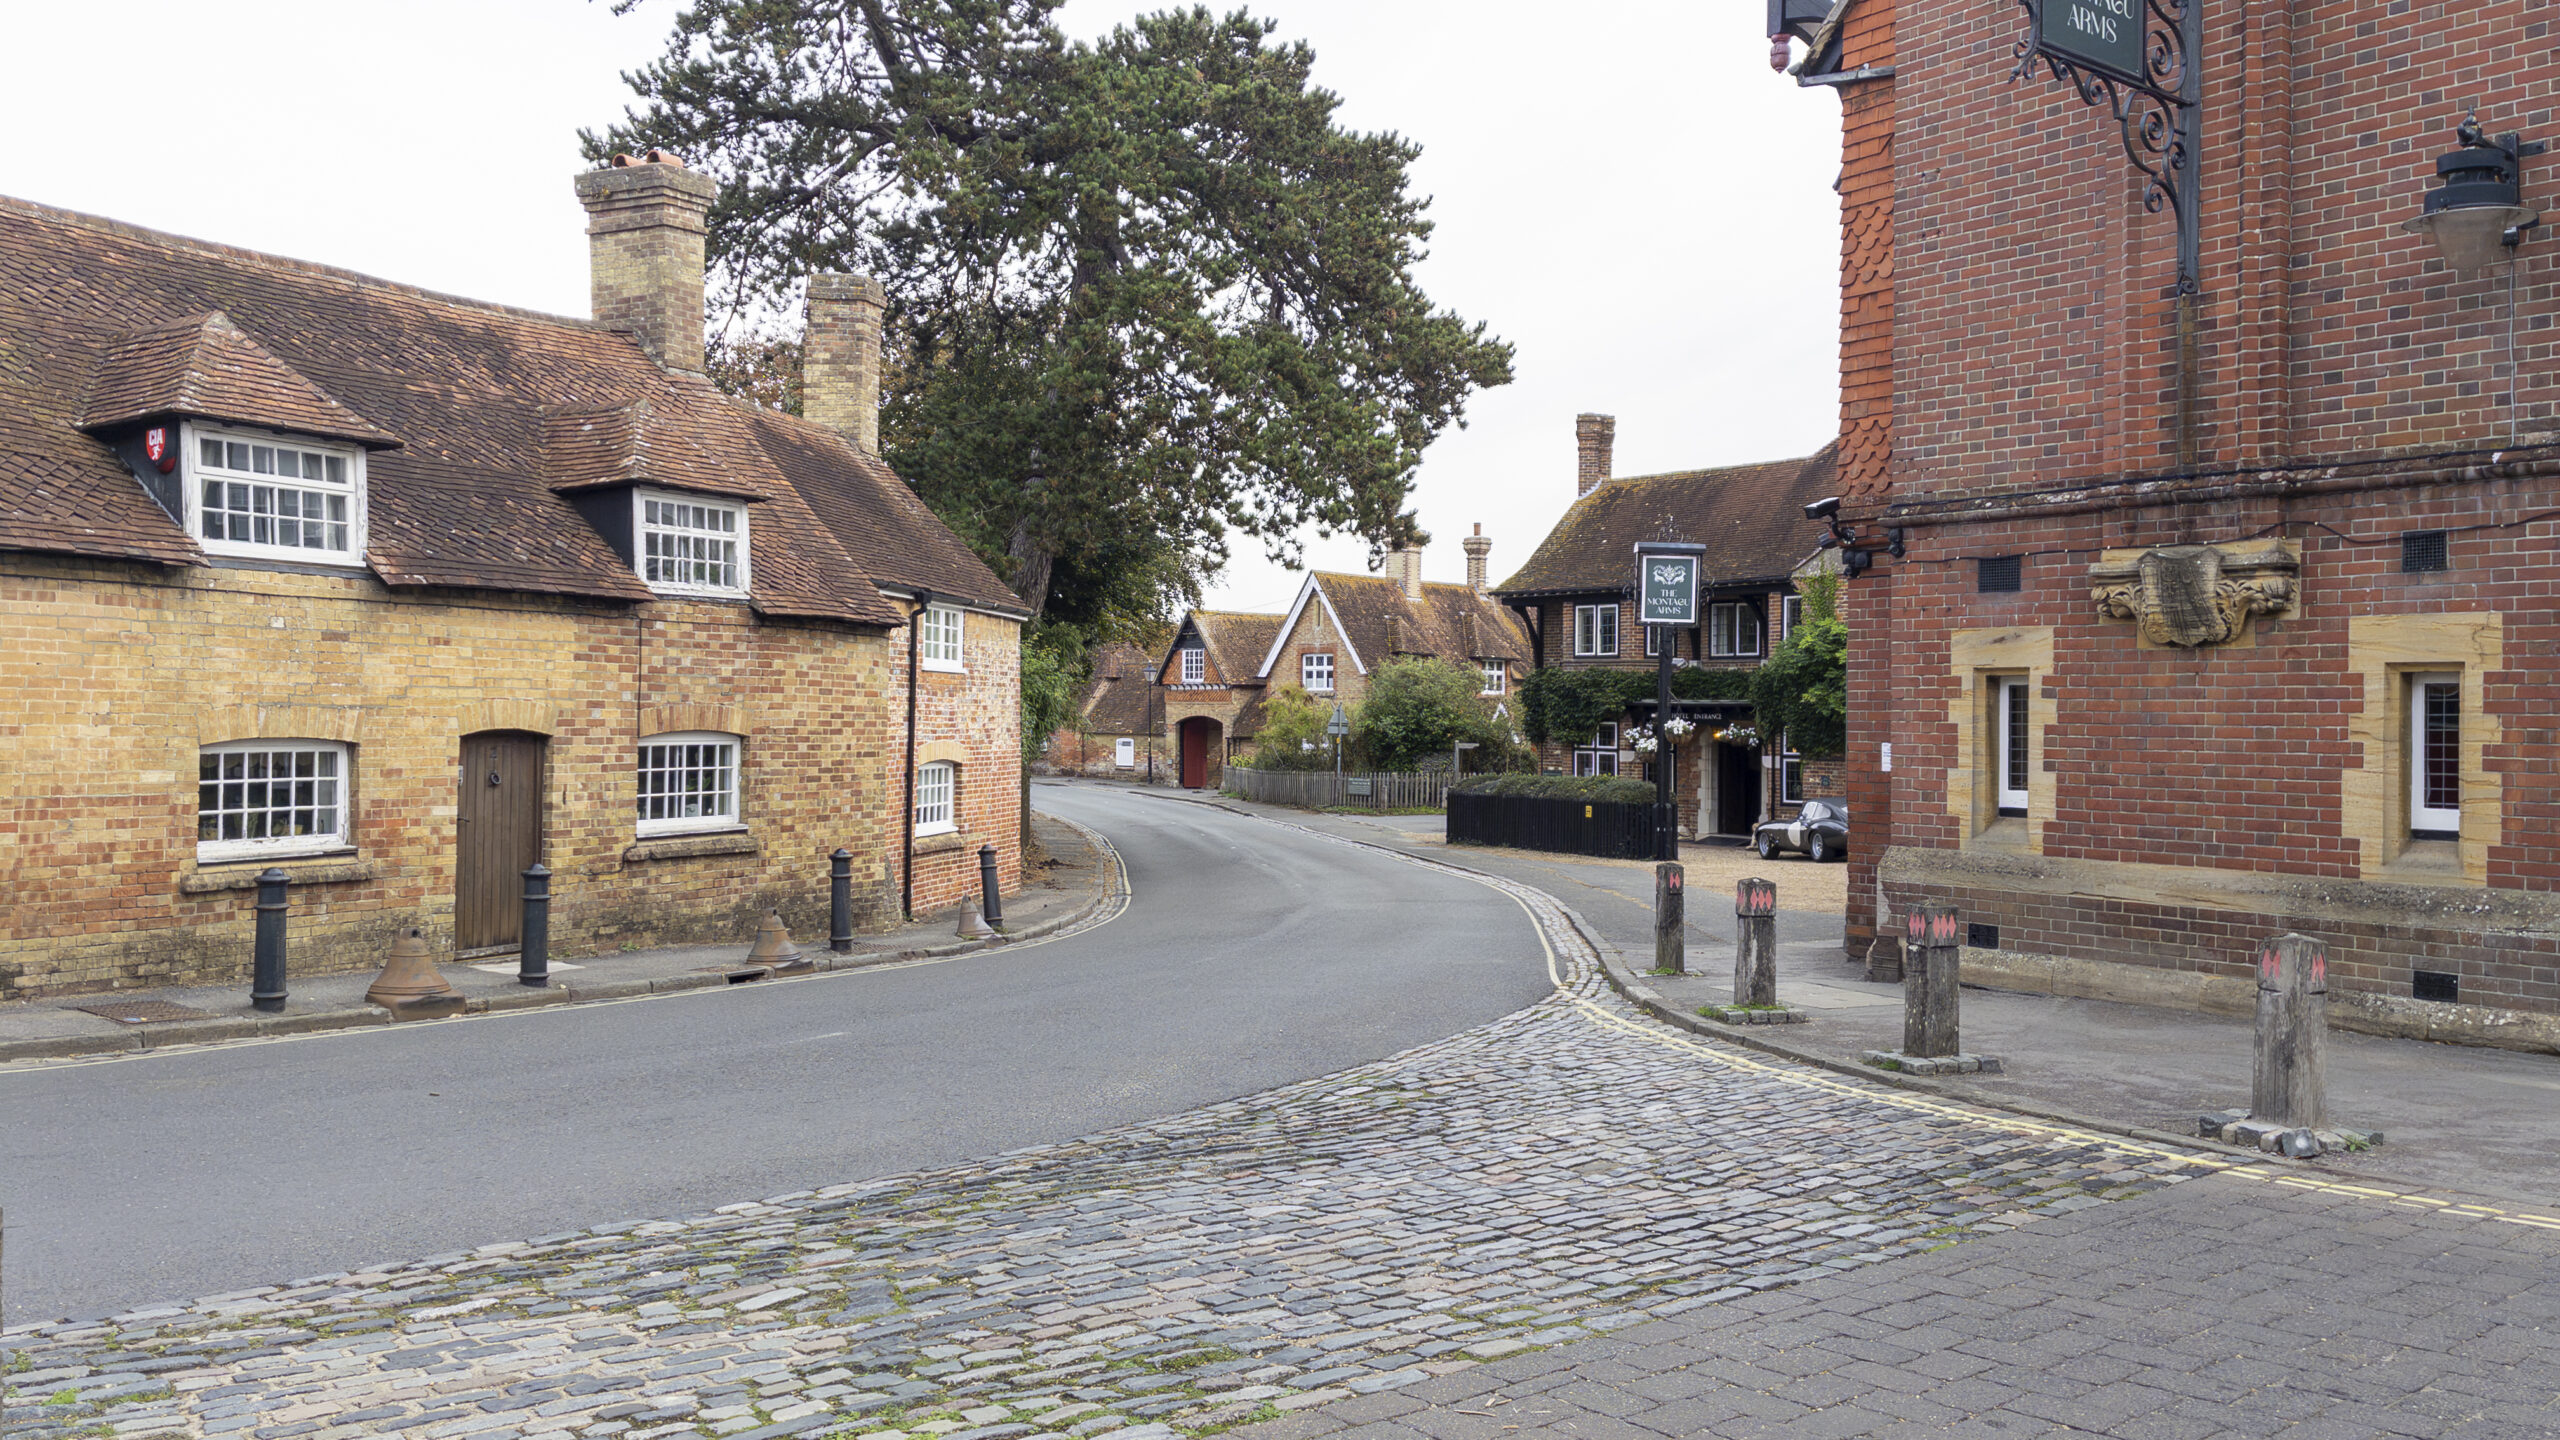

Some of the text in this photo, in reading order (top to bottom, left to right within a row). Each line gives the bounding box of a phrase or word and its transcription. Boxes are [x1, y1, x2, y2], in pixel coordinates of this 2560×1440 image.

[2067, 3, 2117, 43] ARMS
[148, 428, 164, 446] CIA
[1661, 589, 1677, 597] THE
[1647, 597, 1689, 606] MONTAGU
[1655, 606, 1682, 615] ARMS
[1693, 712, 1722, 720] ENTRANCE
